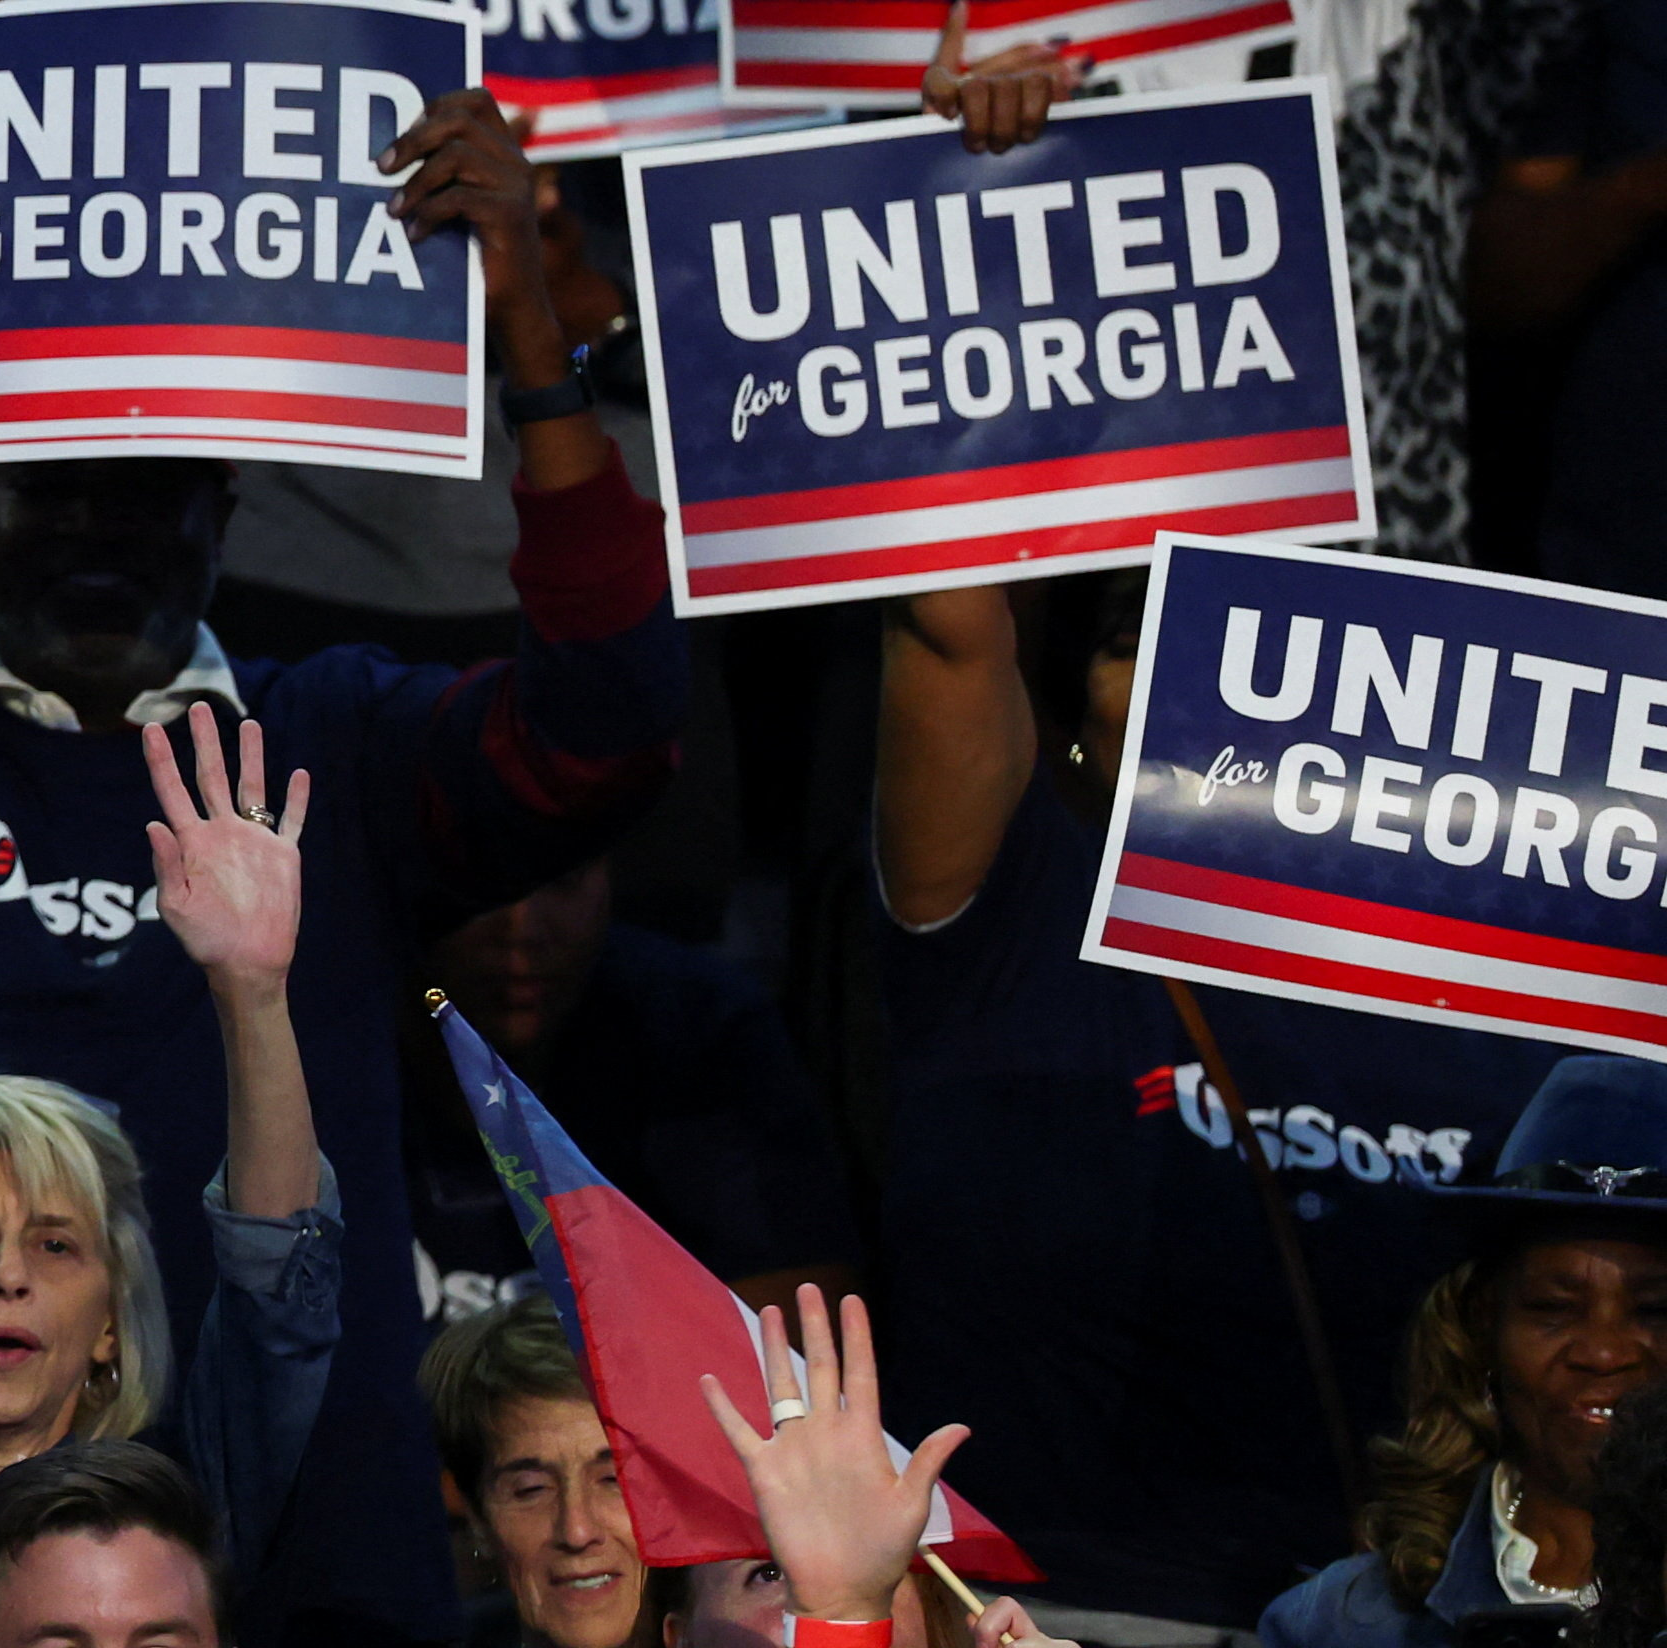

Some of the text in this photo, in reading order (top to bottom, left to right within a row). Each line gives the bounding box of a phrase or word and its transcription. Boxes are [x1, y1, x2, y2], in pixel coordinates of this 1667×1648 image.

[710, 163, 1281, 343] UNITED
[733, 296, 1295, 444] for GEORGIA
[1218, 605, 1667, 799] UNITE
[1198, 742, 1667, 908] for GEORG
